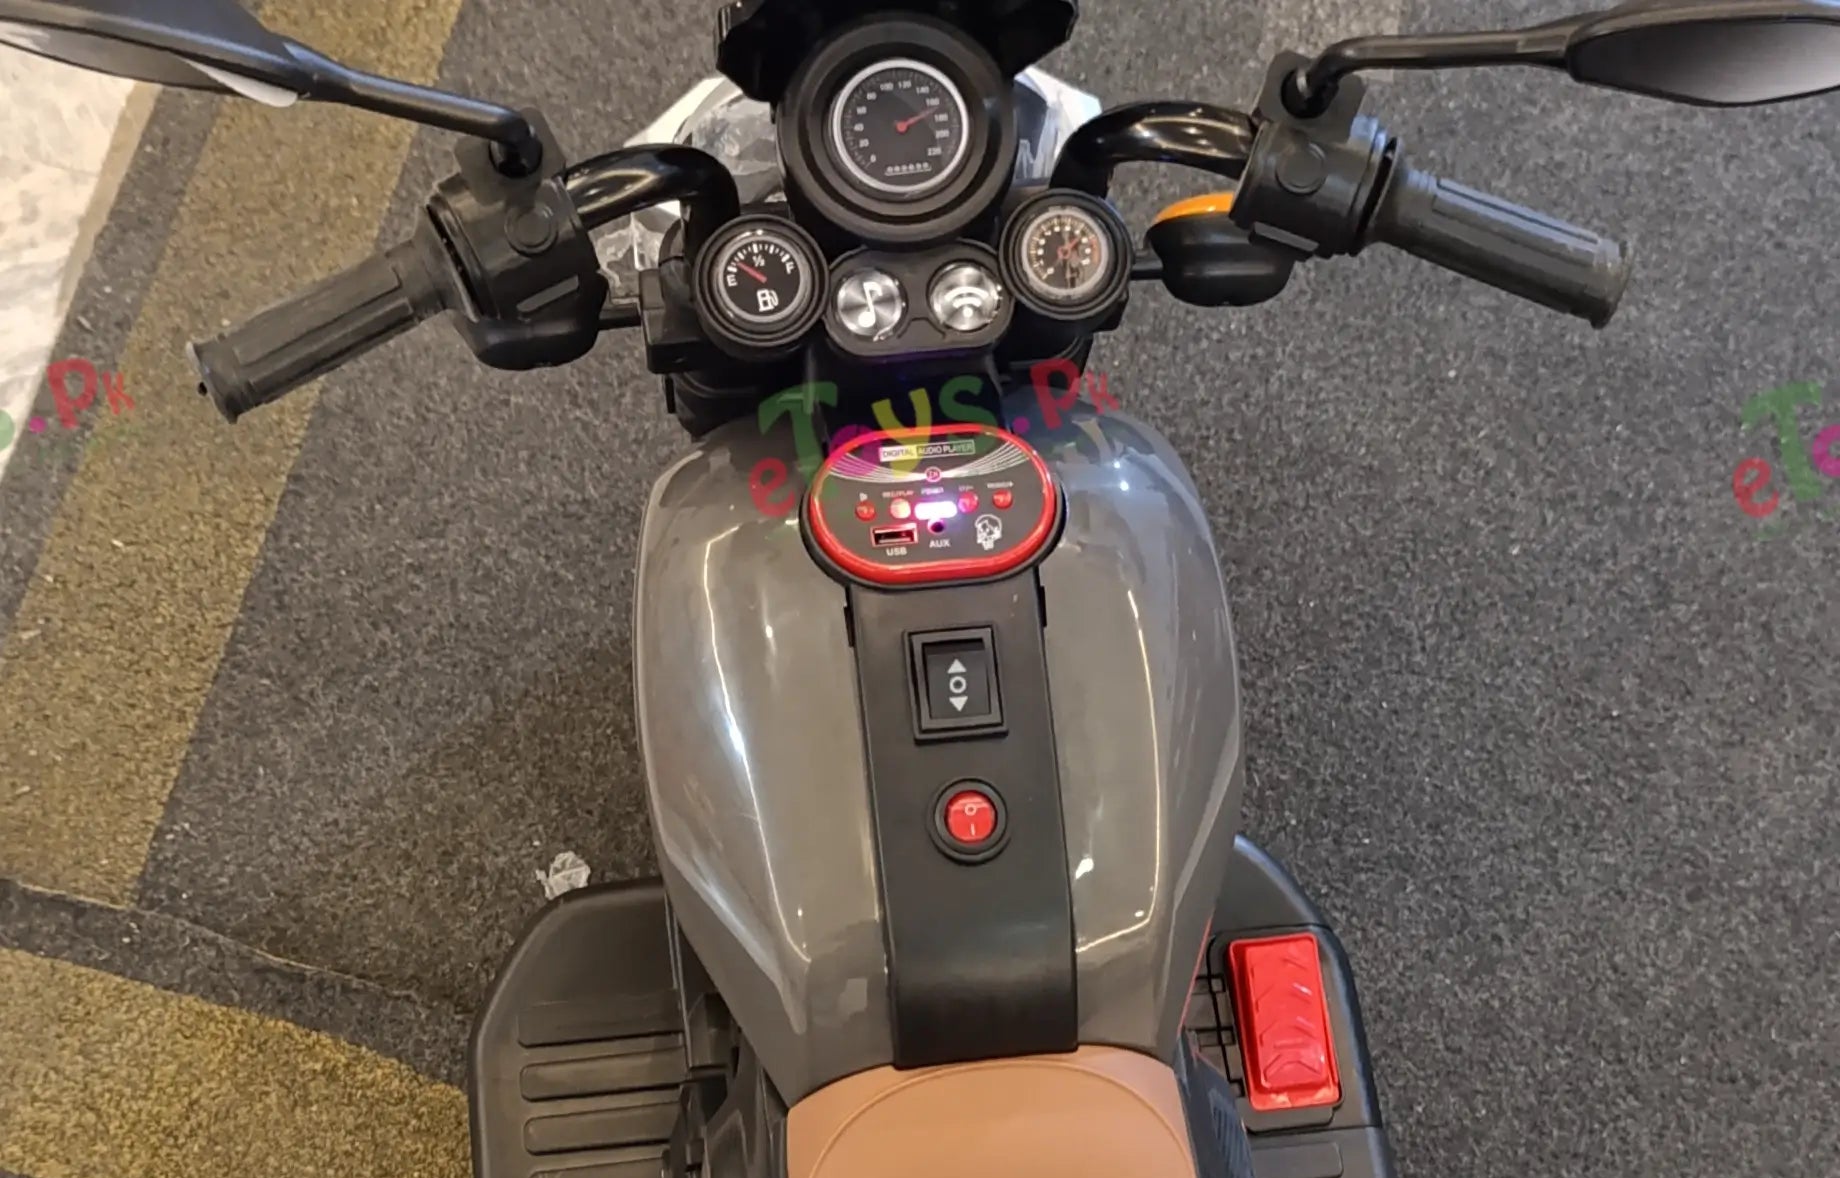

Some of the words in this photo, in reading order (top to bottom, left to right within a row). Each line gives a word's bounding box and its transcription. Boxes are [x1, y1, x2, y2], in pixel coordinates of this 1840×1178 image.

[785, 261, 795, 275] F
[726, 274, 738, 287] E
[882, 449, 915, 458] DIGITAL
[918, 446, 942, 456] AUDIO
[943, 443, 974, 454] PLAYER
[929, 539, 951, 548] AUX
[886, 547, 908, 556] USB
